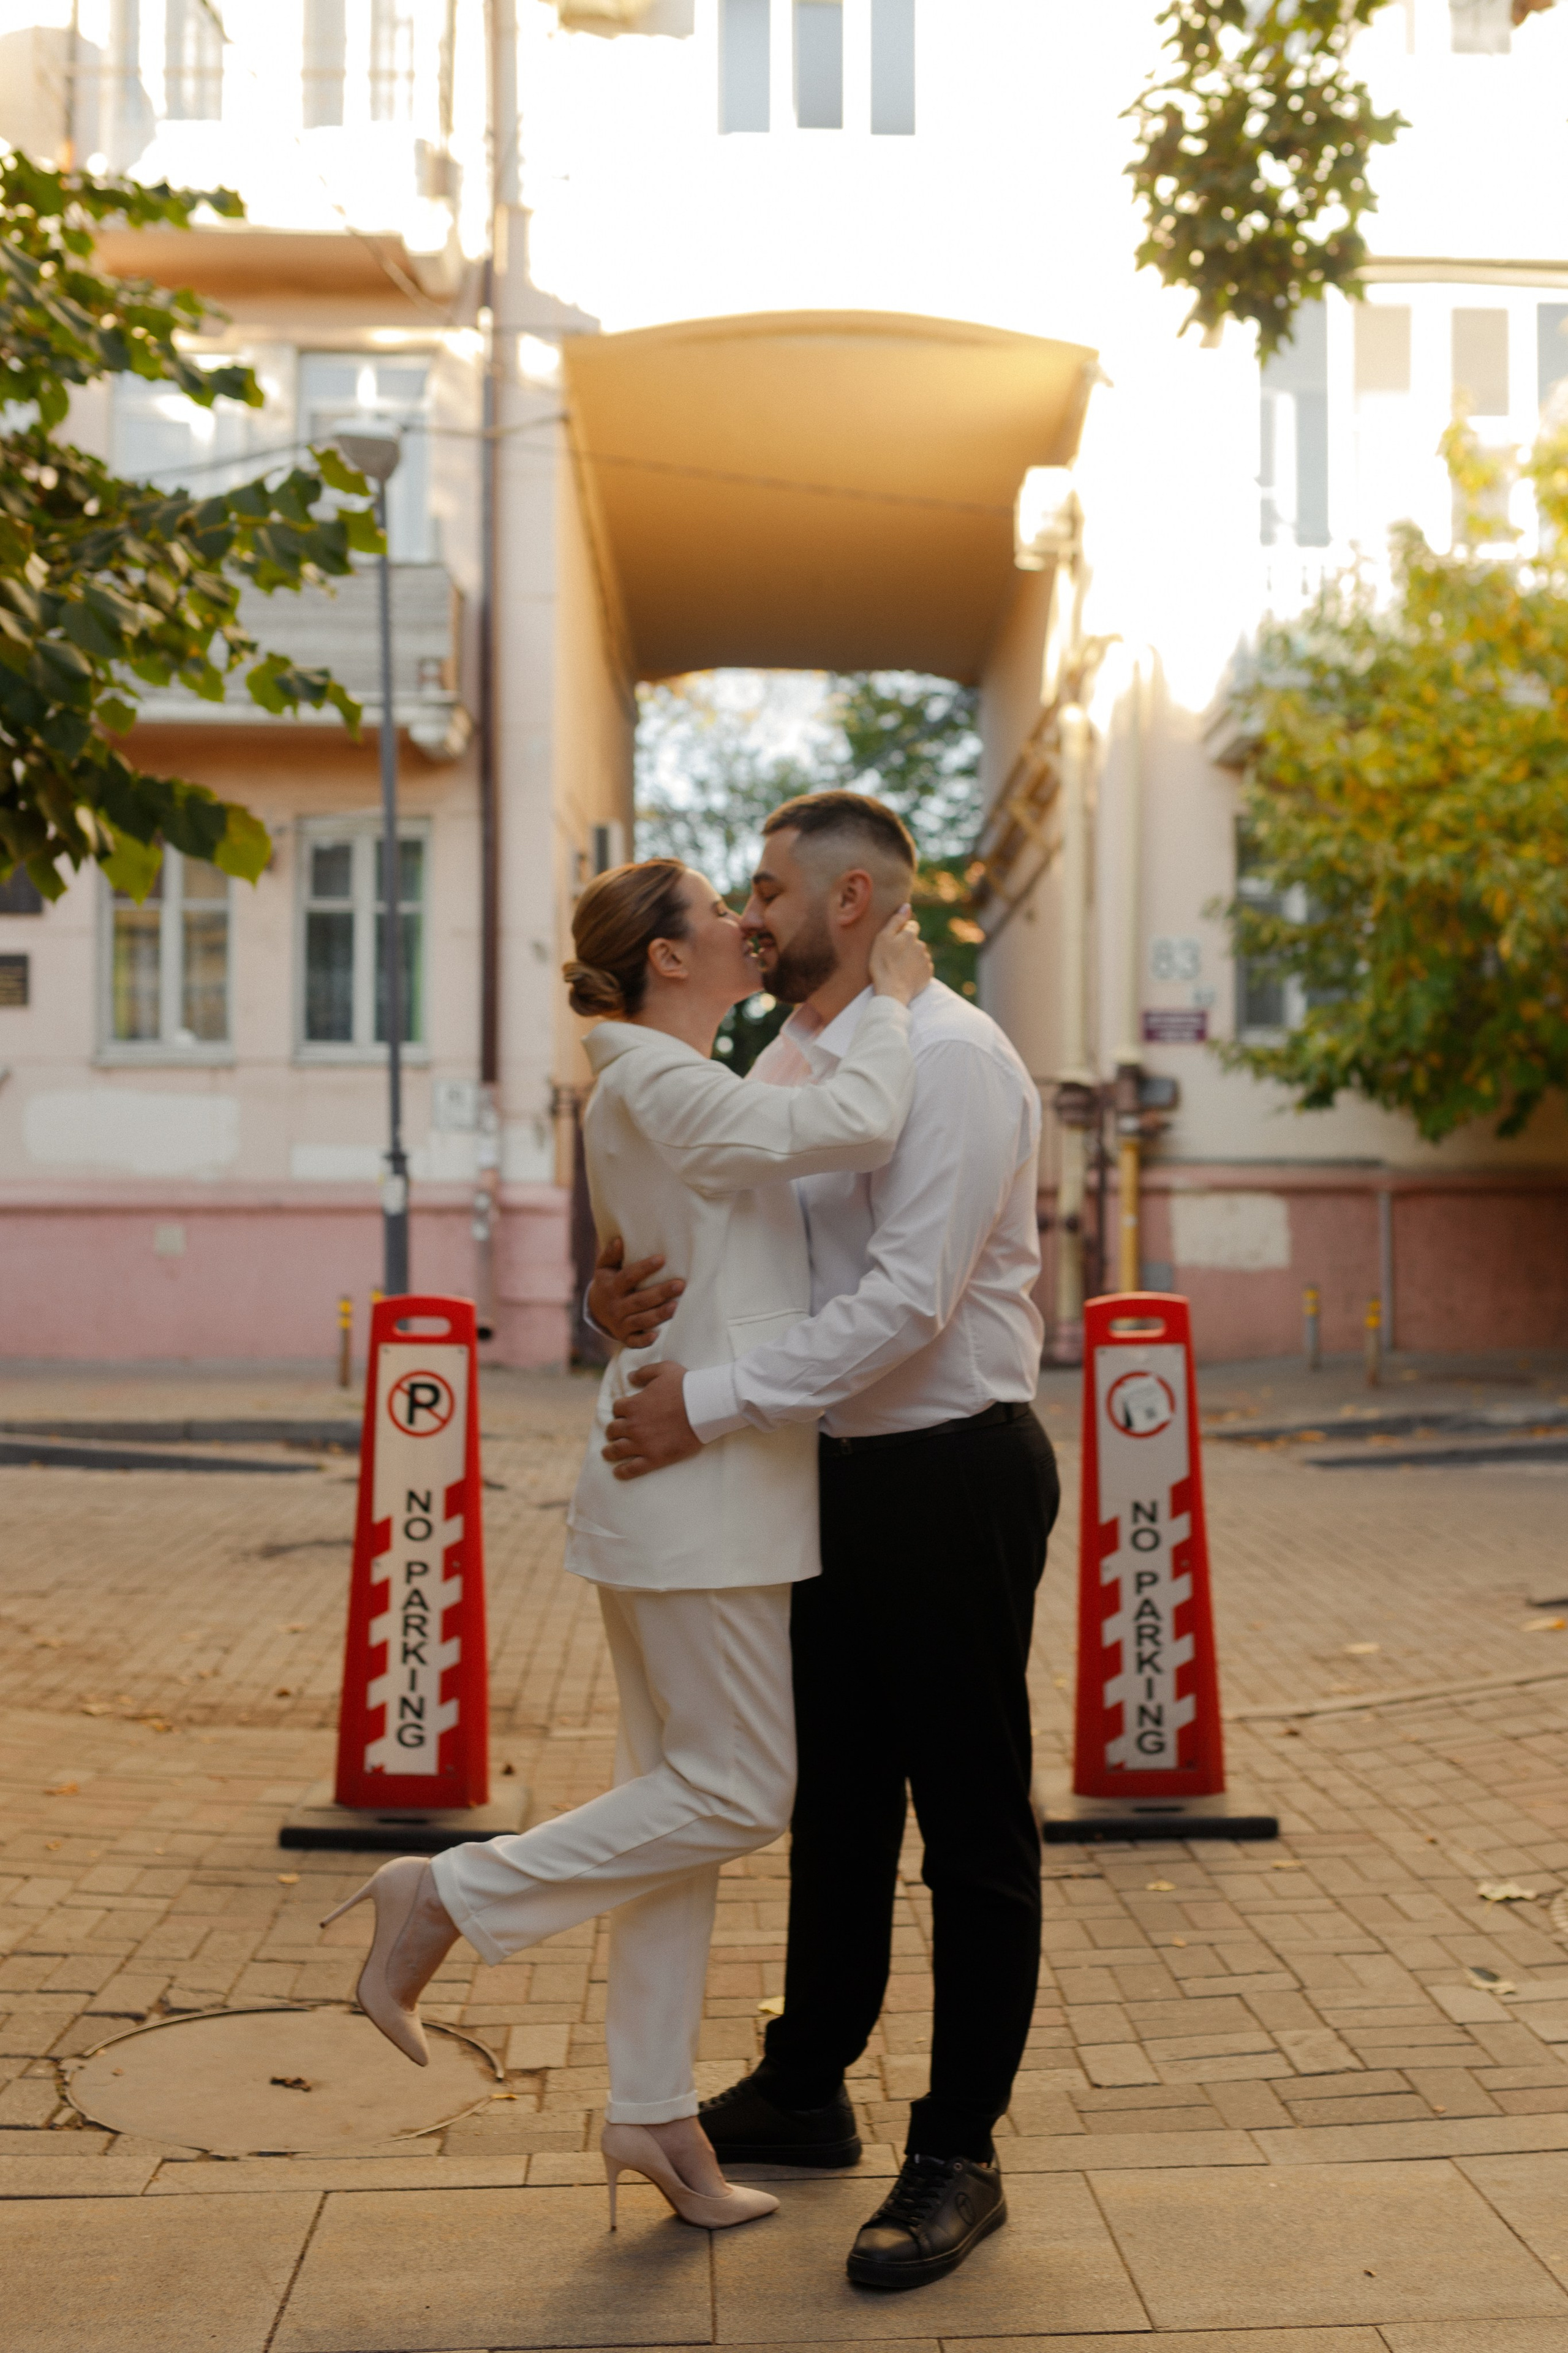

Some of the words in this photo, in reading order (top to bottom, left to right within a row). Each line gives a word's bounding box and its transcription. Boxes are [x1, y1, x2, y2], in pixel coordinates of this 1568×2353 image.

[407, 1382, 441, 1426] P
[404, 1490, 433, 1542] NO
[1131, 1501, 1161, 1552] NO
[397, 1562, 430, 1748] PARKING
[1134, 1572, 1167, 1756] PARKING
